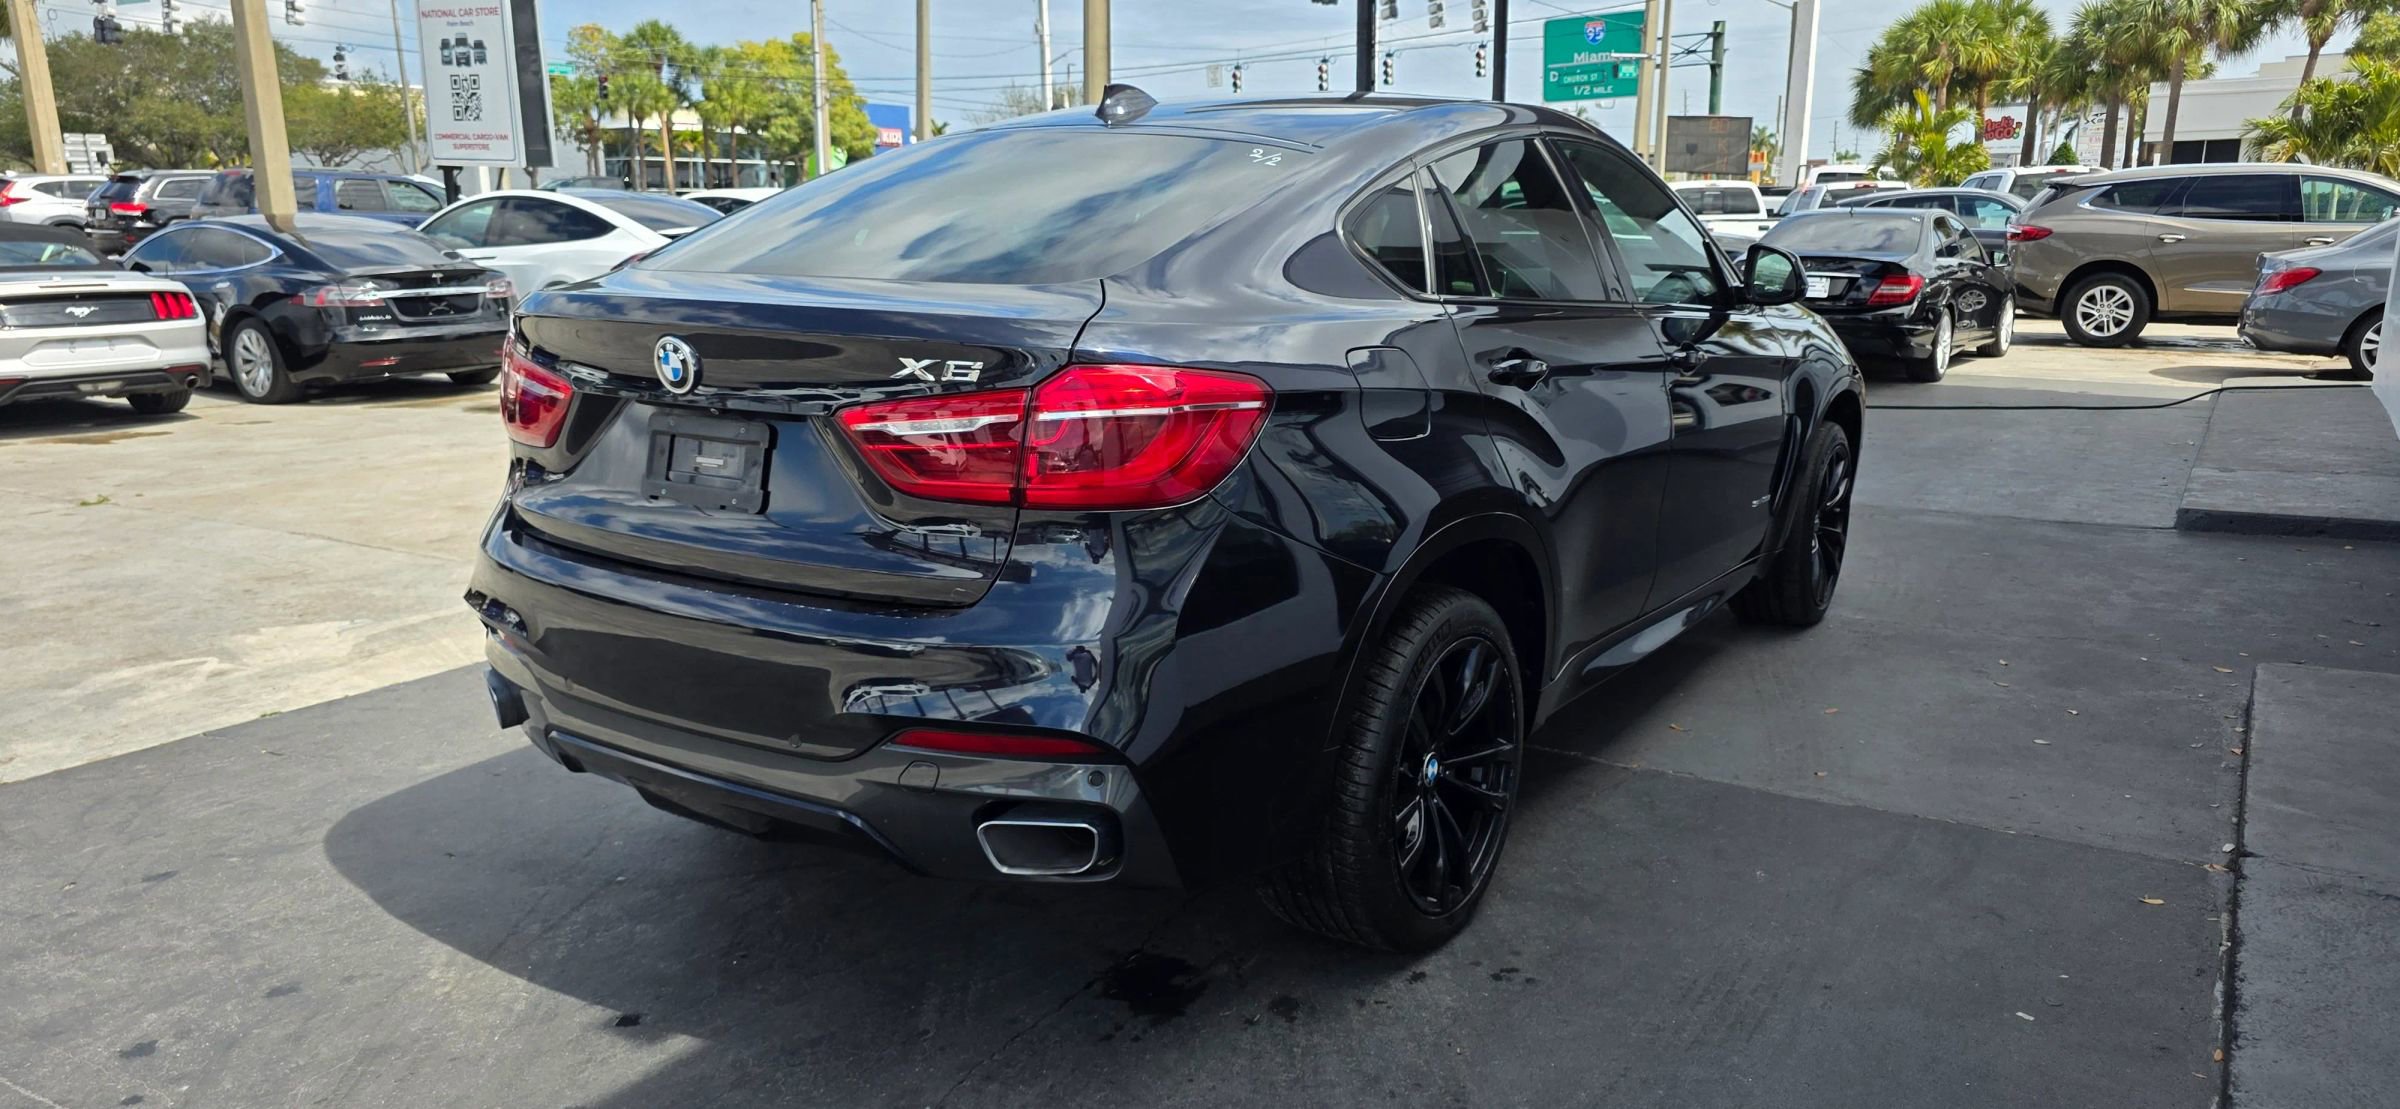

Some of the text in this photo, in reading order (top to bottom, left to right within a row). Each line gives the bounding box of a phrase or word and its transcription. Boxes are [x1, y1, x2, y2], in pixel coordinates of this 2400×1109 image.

[421, 7, 500, 18] NATIONAL CAR STORE
[1586, 26, 1604, 40] 95
[1573, 85, 1614, 95] 1/2 MILE
[1249, 148, 1282, 166] 2/2
[889, 357, 984, 382] X6
